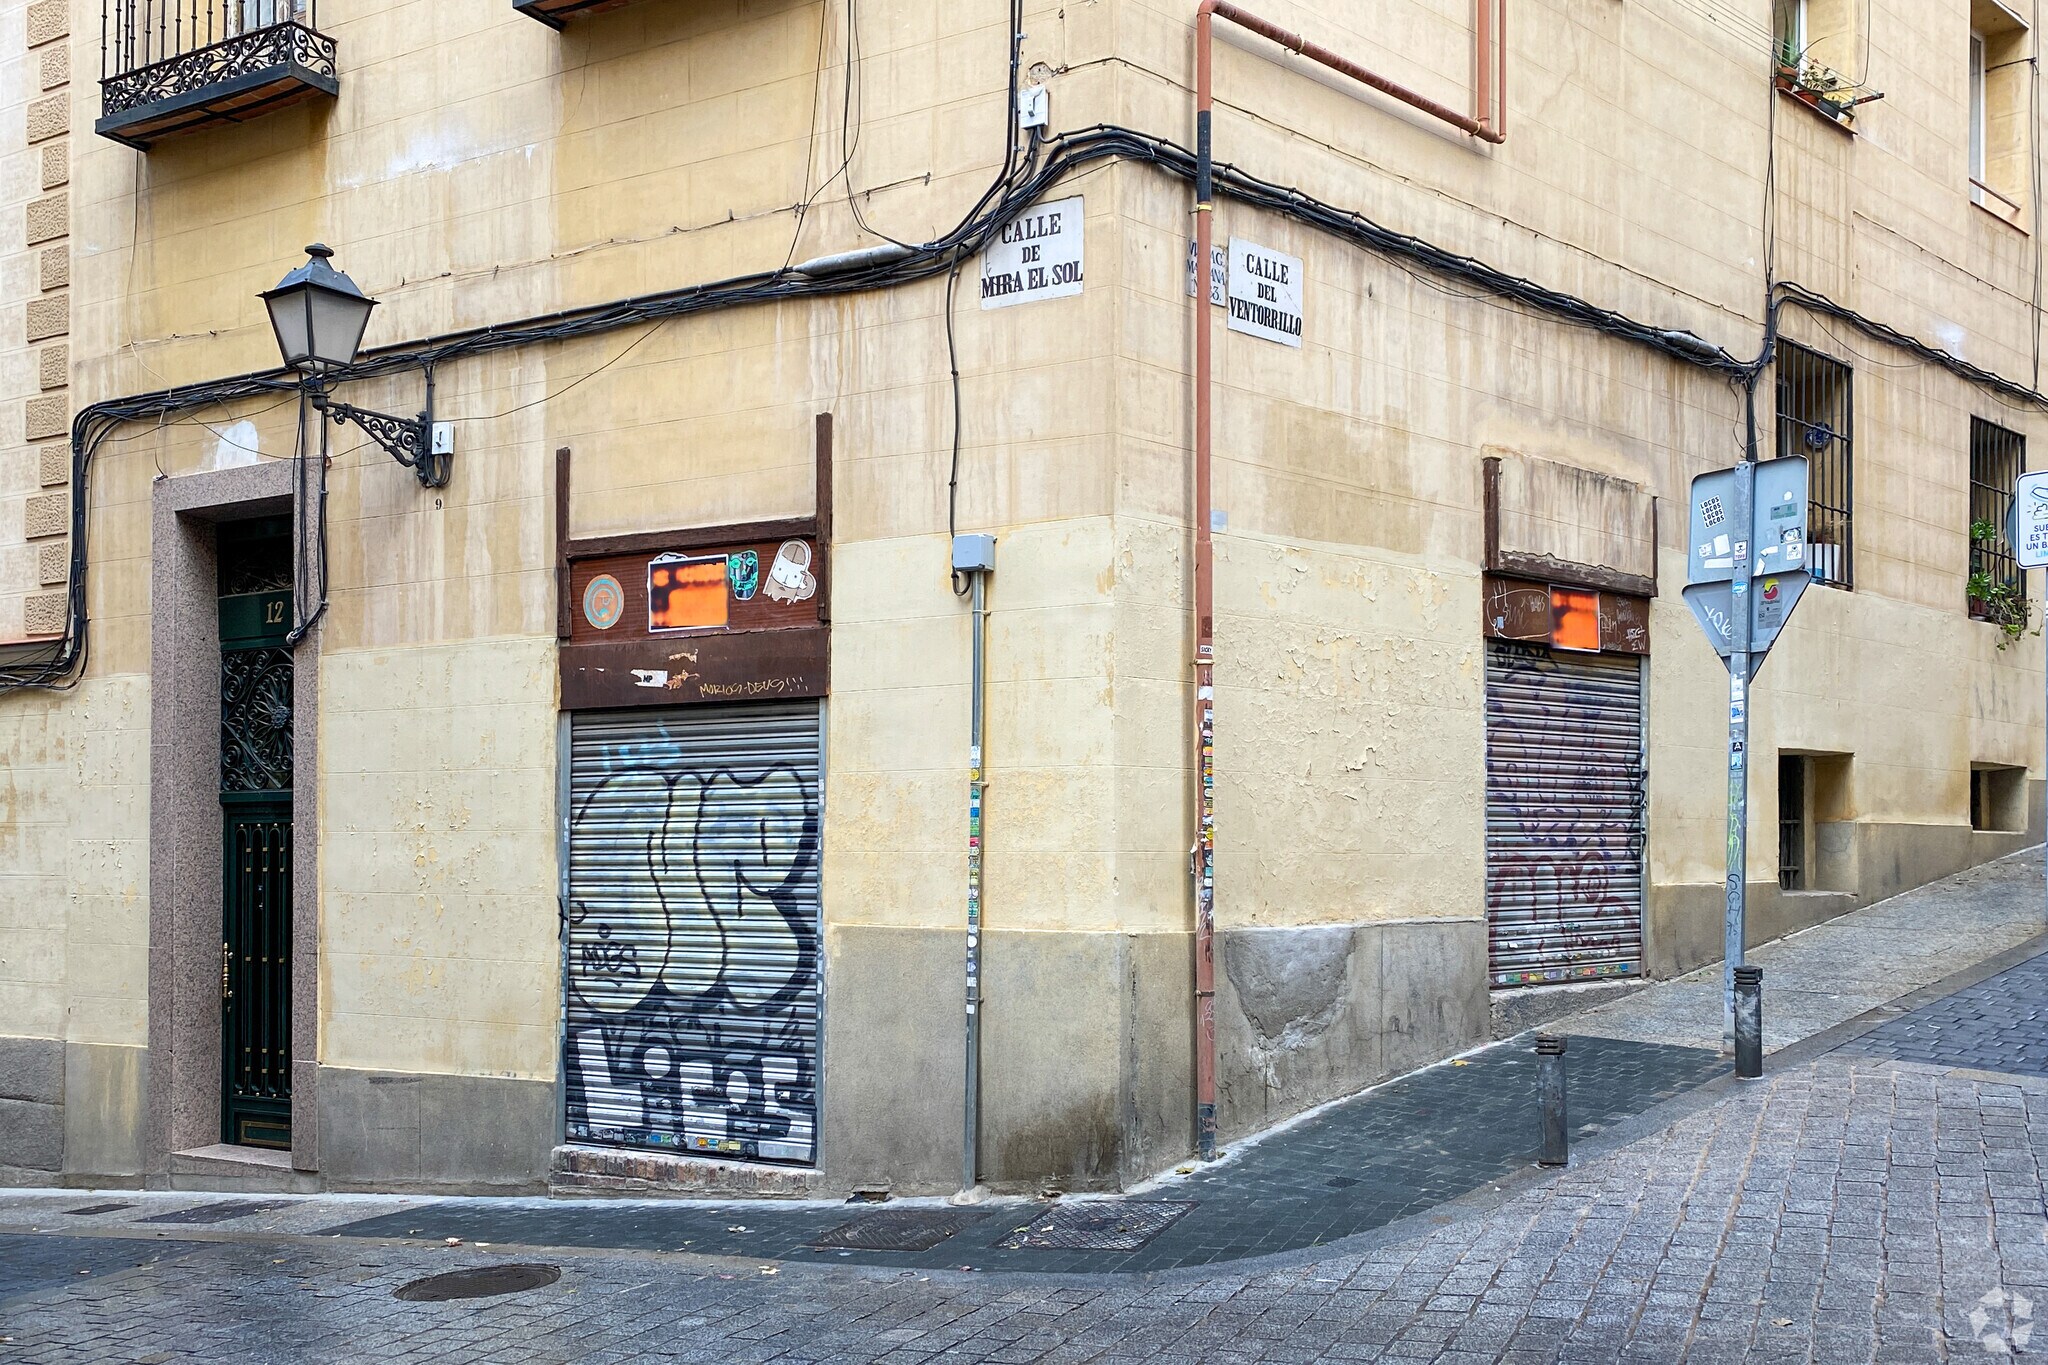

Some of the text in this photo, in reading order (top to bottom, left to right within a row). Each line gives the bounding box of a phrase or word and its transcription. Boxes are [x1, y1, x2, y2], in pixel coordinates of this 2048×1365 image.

[1001, 213, 1061, 244] CALLE
[1021, 244, 1041, 264] DE
[1246, 253, 1289, 285] CALLE
[981, 260, 1083, 299] MIRA EL SOL
[1257, 282, 1277, 303] DEL
[1229, 296, 1302, 337] VENTORRILLO
[435, 498, 442, 510] 9
[1700, 496, 1719, 509] LOCOS
[1702, 502, 1721, 515] LOCOS
[1703, 508, 1723, 521] LOCOS
[1705, 514, 1725, 528] LOCOS
[2030, 533, 2041, 542] ES
[2026, 542, 2039, 551] UN
[265, 601, 284, 624] 12
